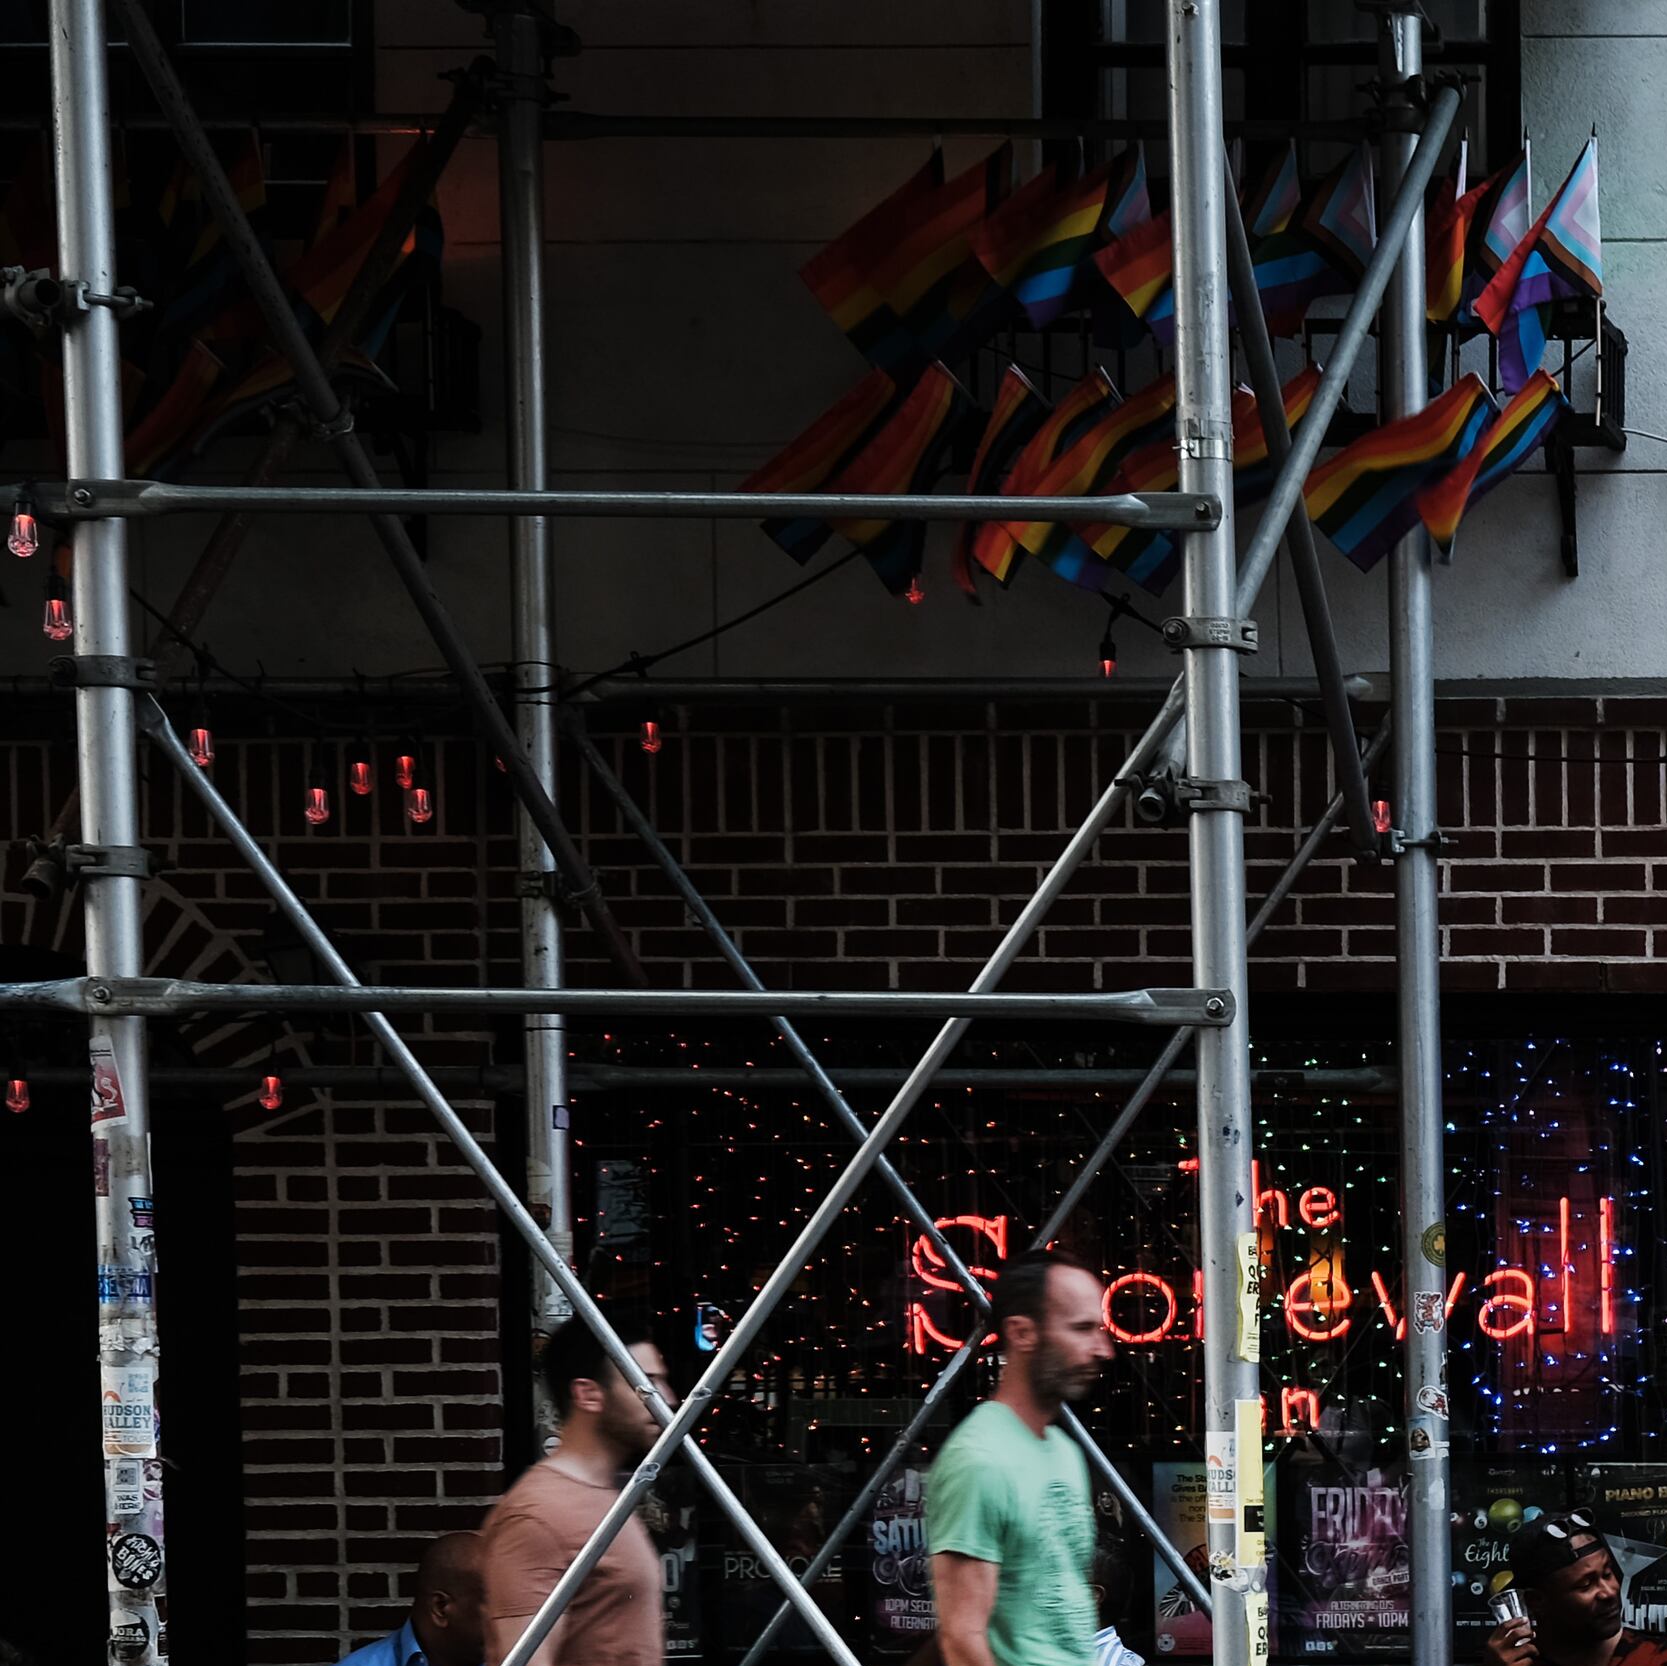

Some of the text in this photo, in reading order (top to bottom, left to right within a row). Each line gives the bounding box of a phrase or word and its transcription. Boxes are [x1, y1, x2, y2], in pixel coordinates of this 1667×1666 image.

[1177, 1475, 1192, 1483] The
[1172, 1484, 1192, 1493] Gives
[1605, 1487, 1654, 1502] PIANO
[1464, 1539, 1510, 1570] Eight
[884, 1600, 909, 1613] 10PM
[1316, 1612, 1408, 1628] FRIDAYS 10PM
